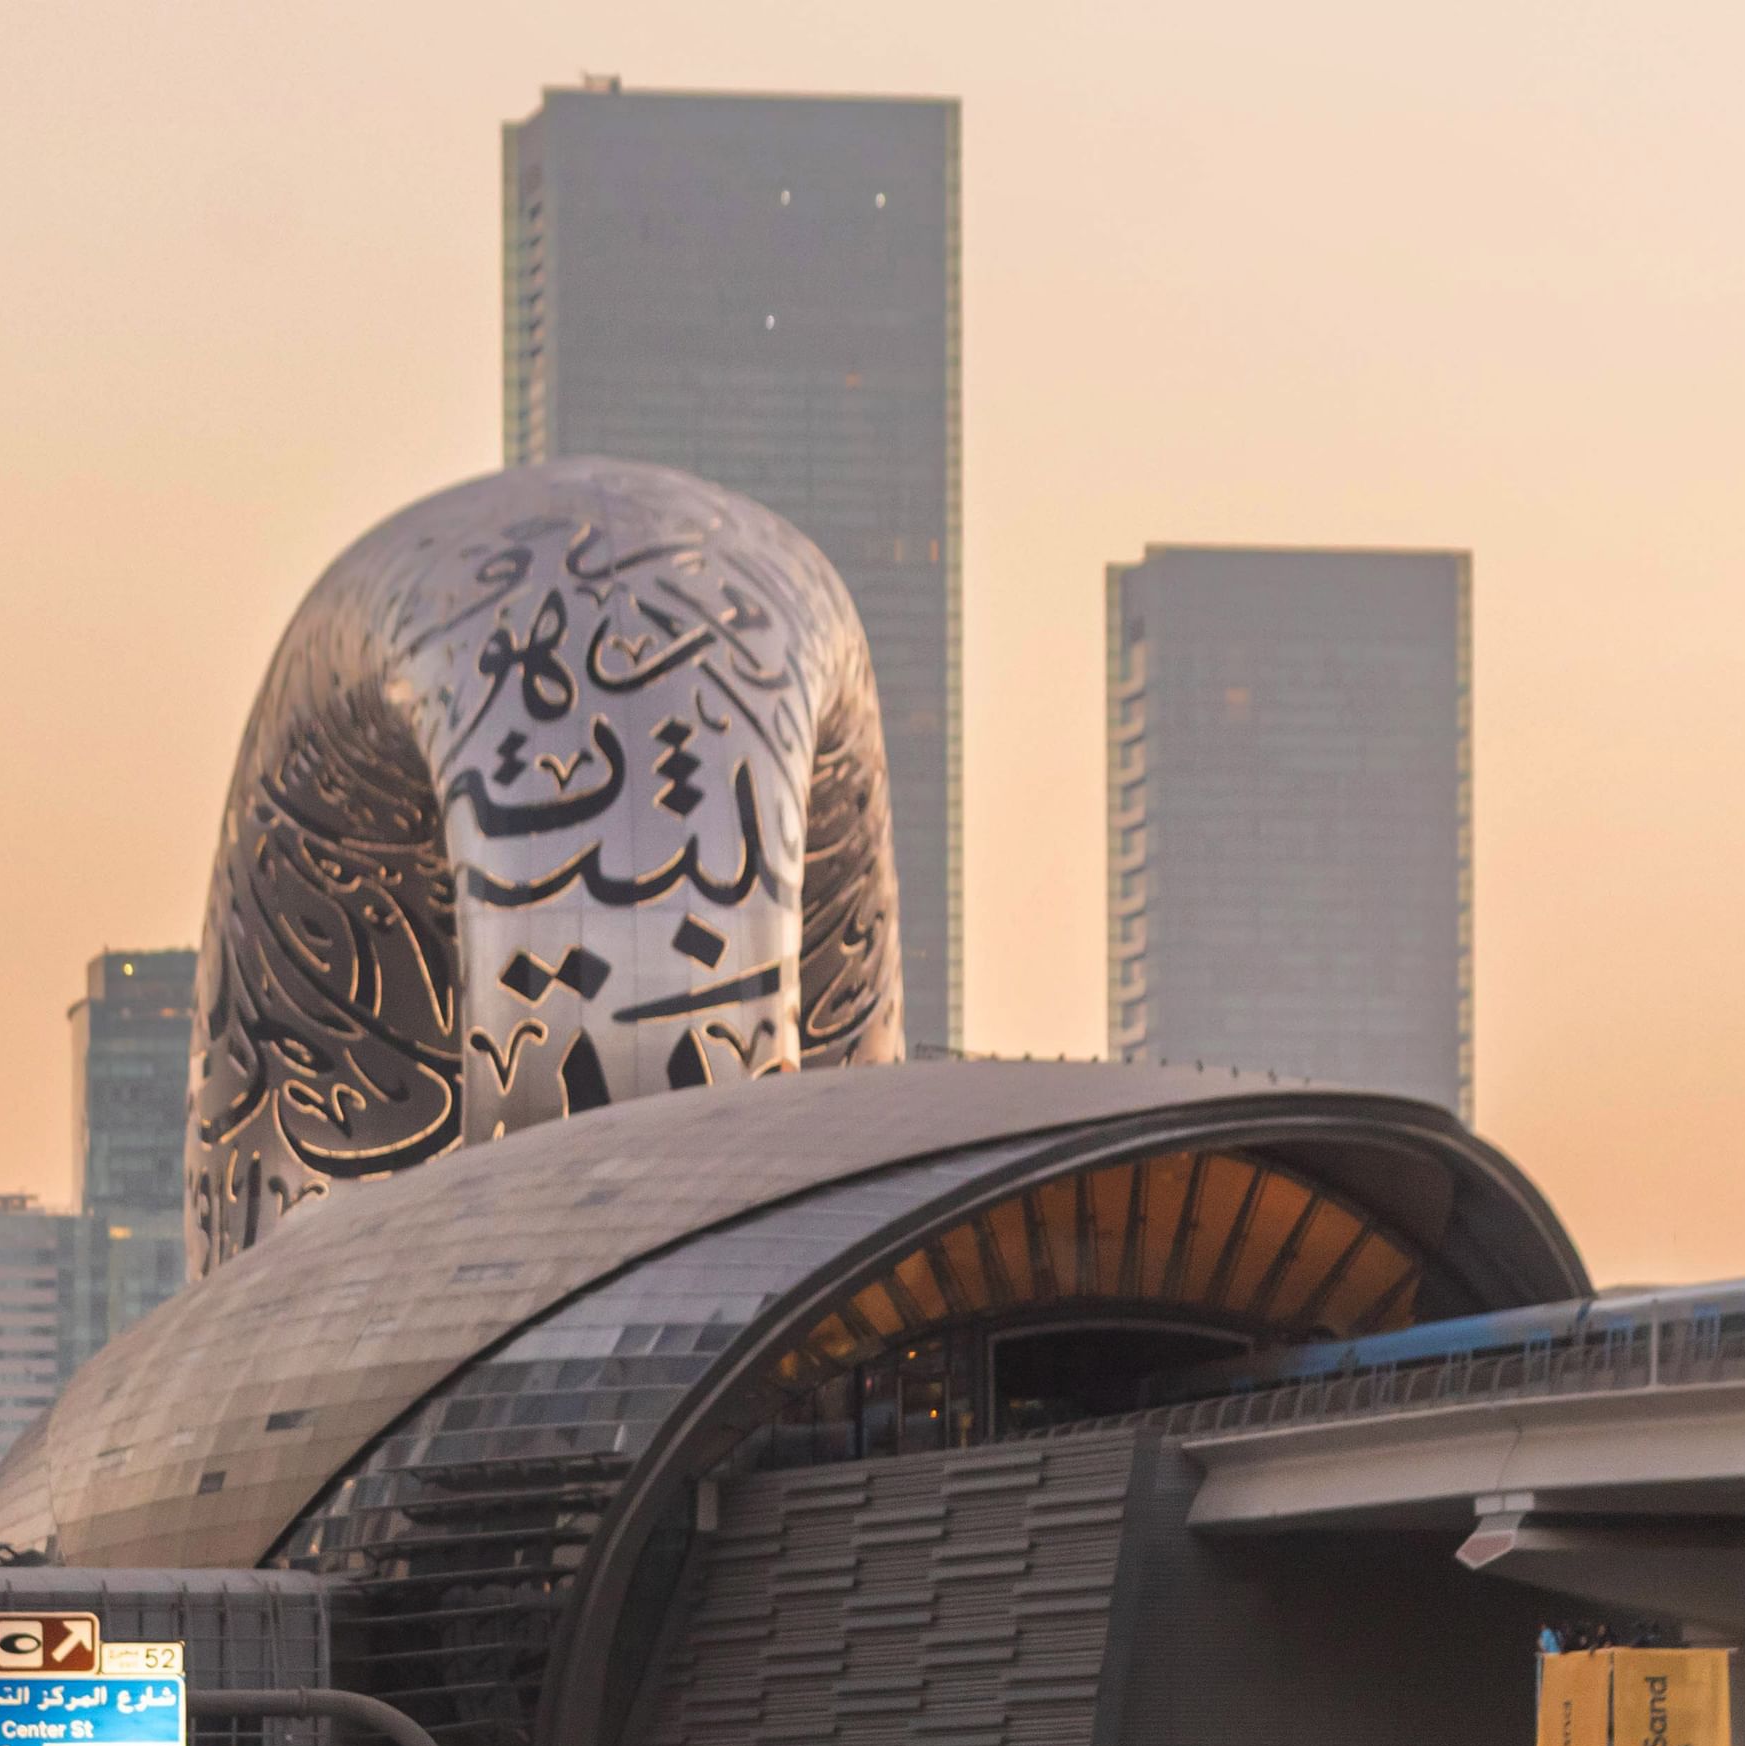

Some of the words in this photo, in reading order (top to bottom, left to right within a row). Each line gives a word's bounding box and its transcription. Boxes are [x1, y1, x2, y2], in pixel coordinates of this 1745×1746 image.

[145, 1648, 175, 1669] 52
[37, 1686, 107, 1712] المركز
[117, 1686, 177, 1714] شارع
[1, 1720, 66, 1739] Center
[70, 1720, 94, 1739] St
